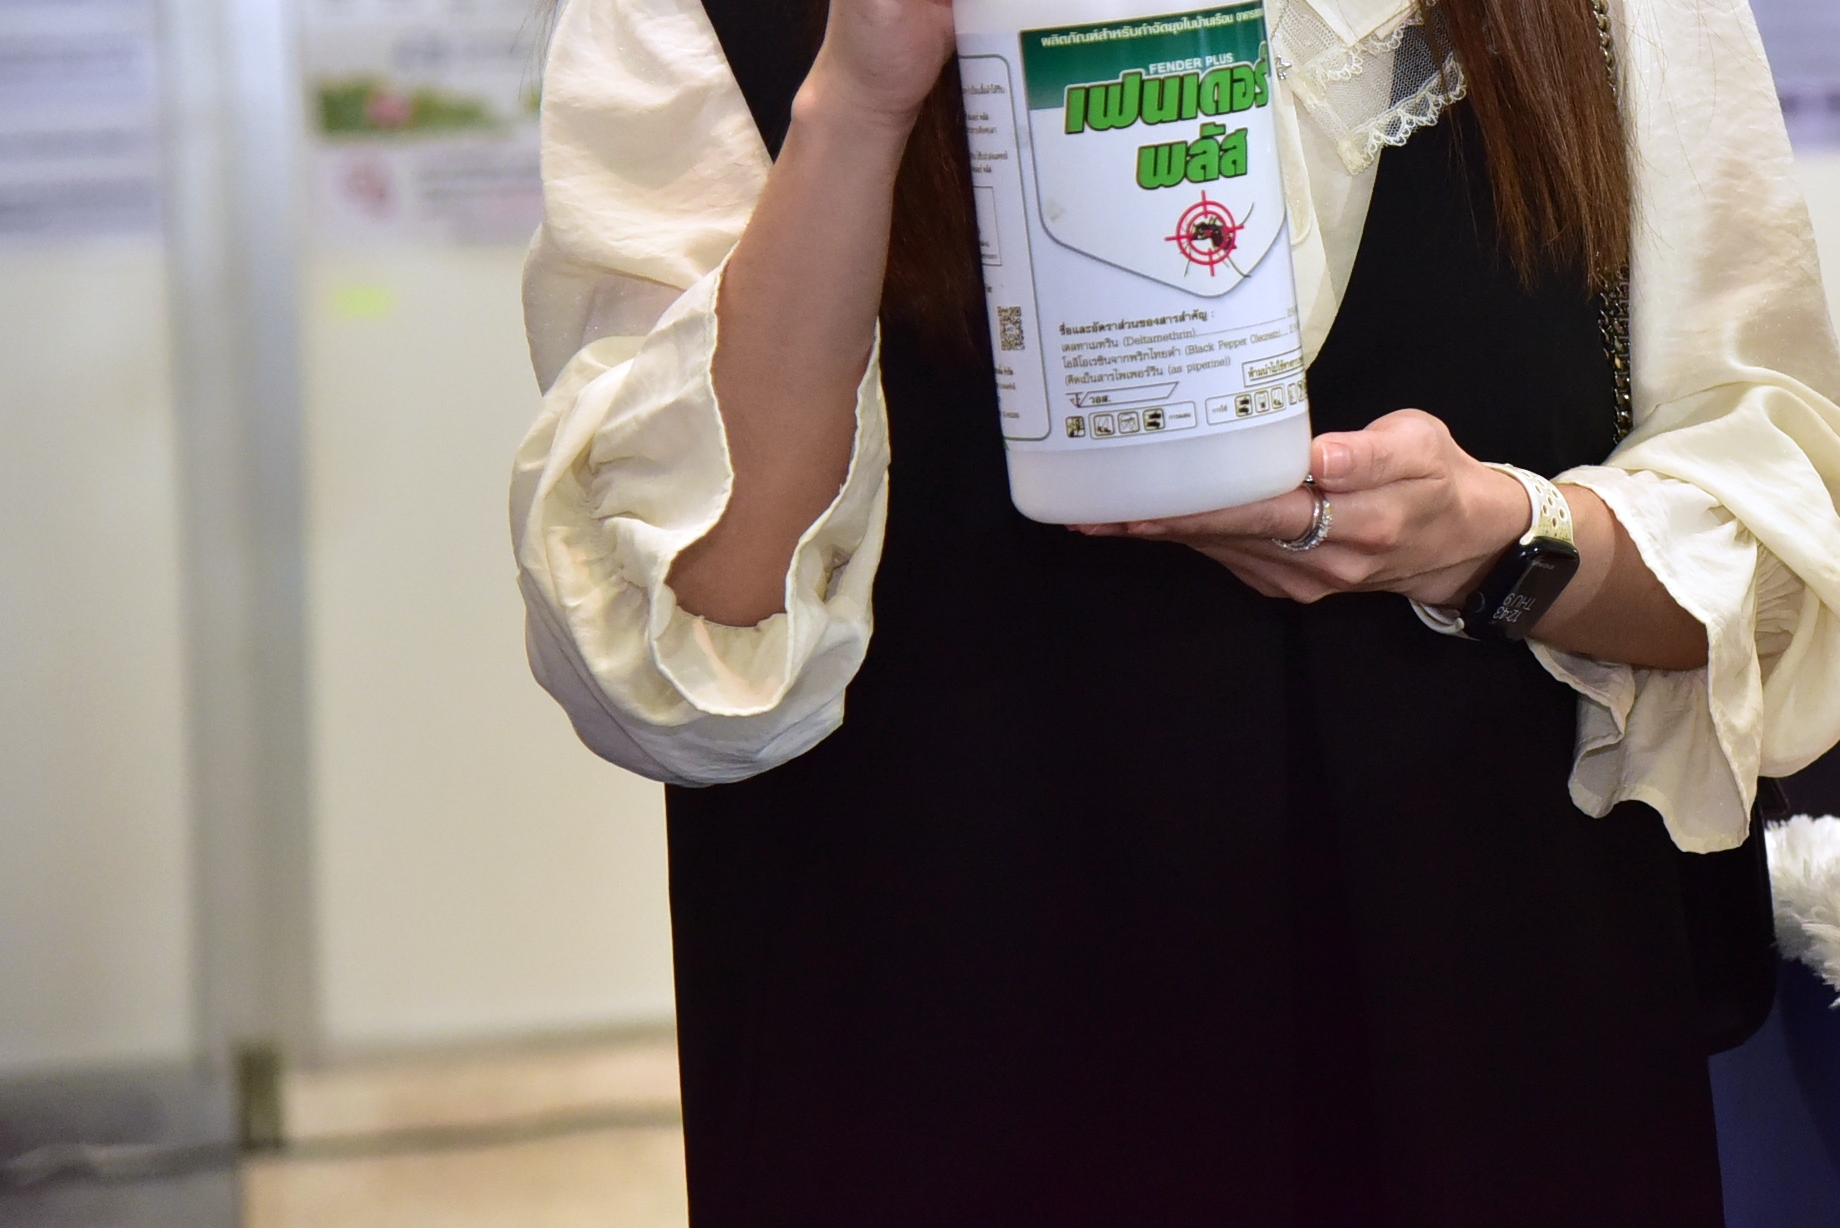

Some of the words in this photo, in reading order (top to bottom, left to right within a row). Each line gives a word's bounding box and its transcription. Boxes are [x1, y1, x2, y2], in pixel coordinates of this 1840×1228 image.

[1149, 58, 1201, 75] FENDER
[1205, 53, 1234, 66] PLUS
[1065, 40, 1269, 134] เฟนเดอร์
[1136, 122, 1248, 190] พลัส
[1185, 342, 1214, 356] (Black
[1218, 337, 1247, 351] Pepper
[1168, 364, 1183, 376] (as
[1503, 592, 1515, 606] 9
[1511, 594, 1536, 611] THU
[1493, 607, 1521, 622] 12:43
